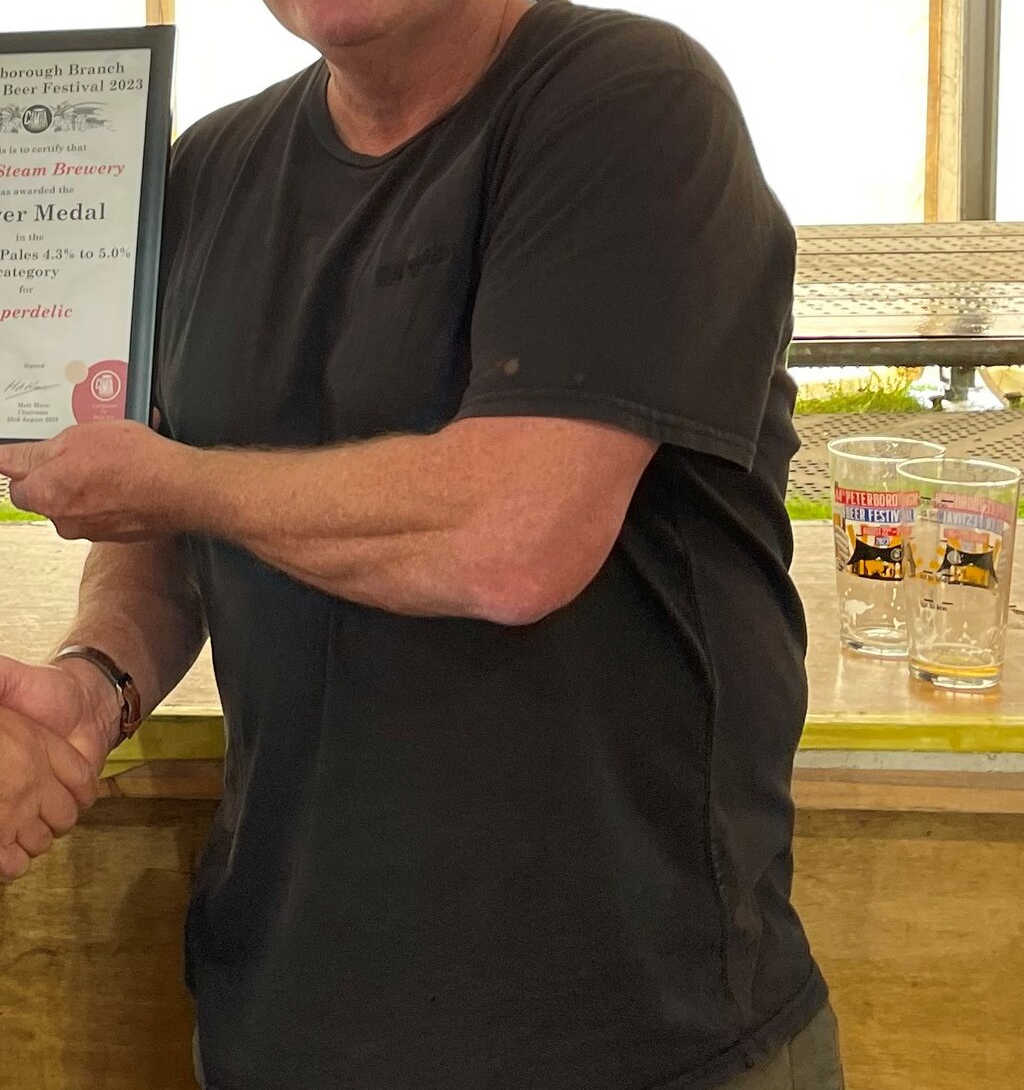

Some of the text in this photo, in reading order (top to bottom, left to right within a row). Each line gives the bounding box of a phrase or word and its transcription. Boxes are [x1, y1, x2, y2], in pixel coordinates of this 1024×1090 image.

[68, 62, 125, 76] Branch
[2, 83, 38, 96] Beer
[43, 80, 104, 94] Festival
[110, 78, 143, 91] 2023
[9, 145, 17, 154] is
[20, 145, 30, 154] to
[32, 144, 64, 155] certify
[67, 143, 87, 152] that
[52, 162, 125, 178] Brewery
[13, 186, 56, 196] awarded
[58, 186, 74, 194] the
[33, 202, 106, 222] Medal
[15, 233, 44, 242] in the
[0, 249, 39, 260] Pales
[43, 249, 75, 260] 4.3%
[80, 248, 94, 259] to
[98, 248, 131, 259] 5.0%
[19, 285, 34, 294] for
